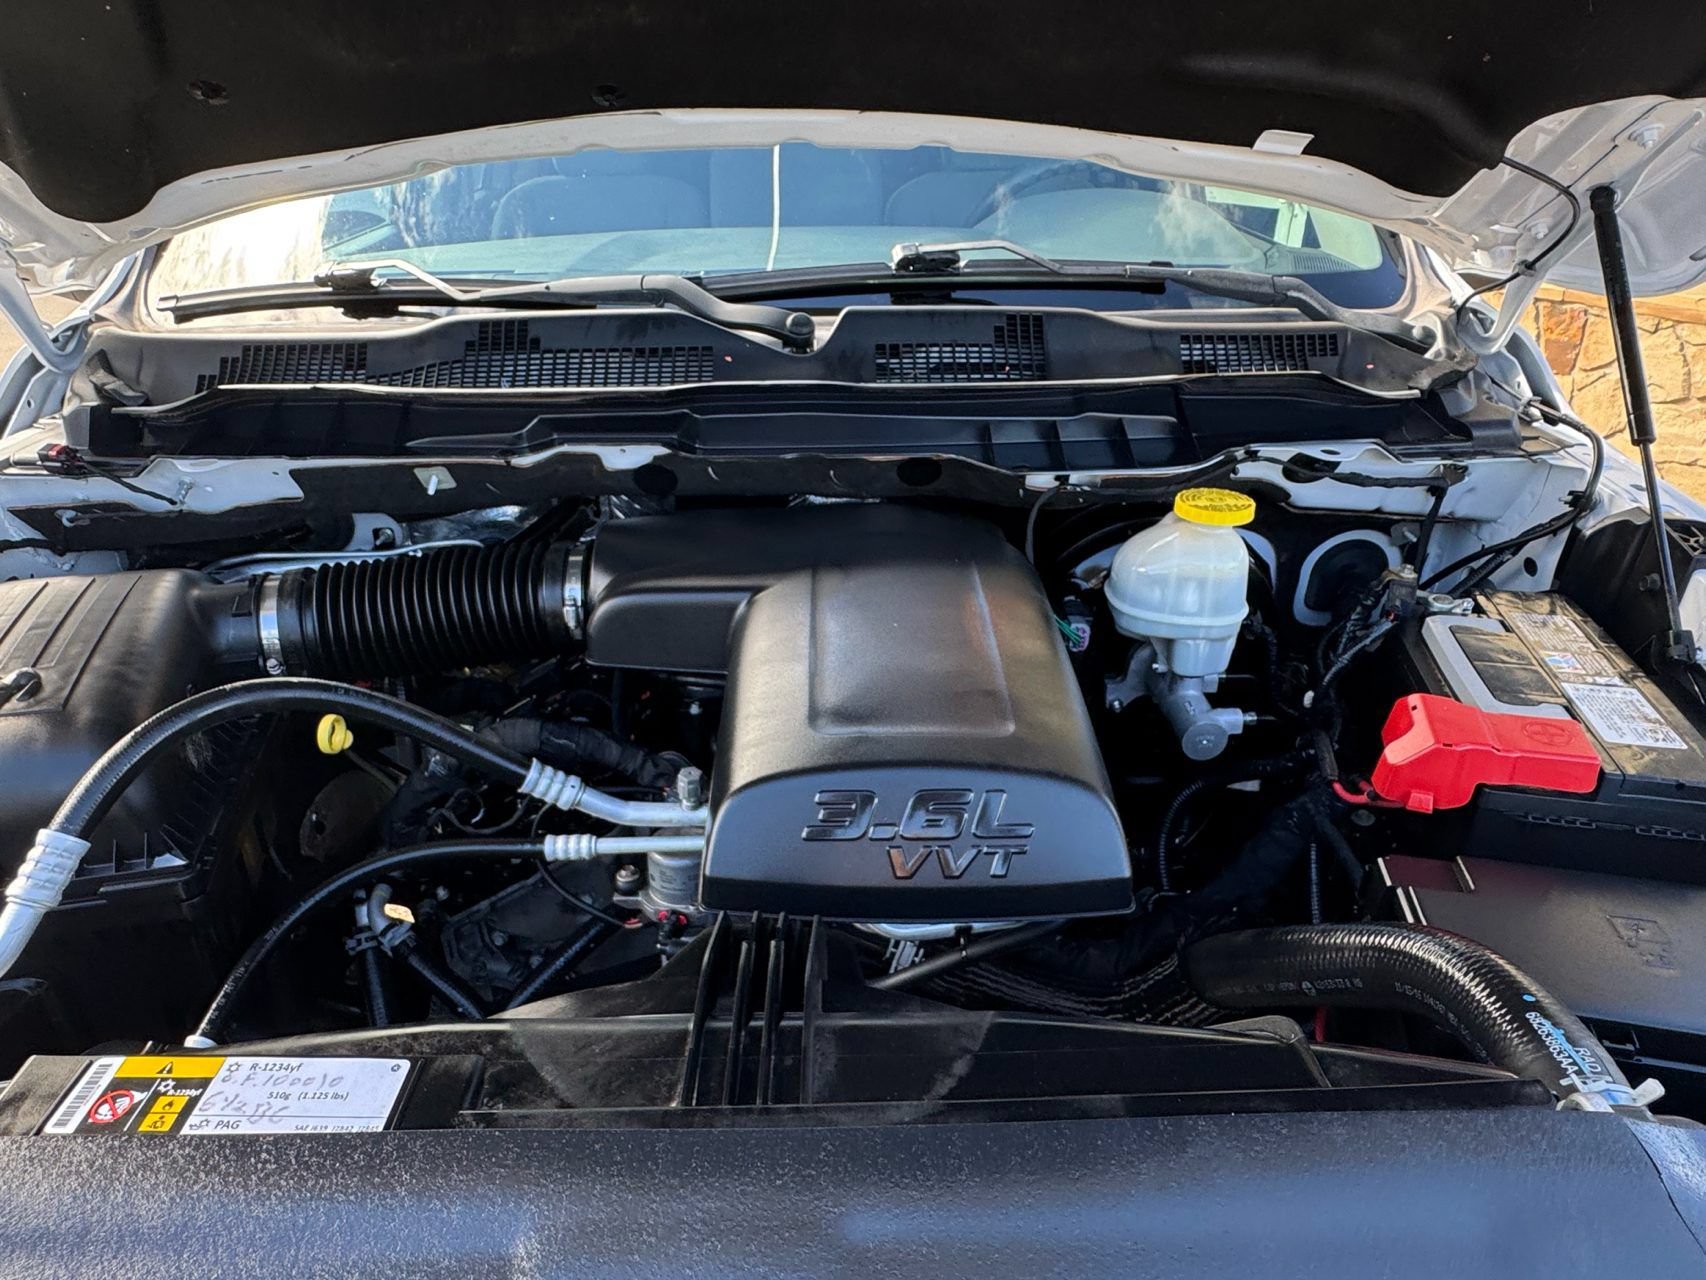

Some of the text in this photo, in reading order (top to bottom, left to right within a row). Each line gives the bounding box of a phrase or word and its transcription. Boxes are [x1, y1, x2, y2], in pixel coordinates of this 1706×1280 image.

[801, 788, 1036, 841] 3.6L
[886, 845, 1031, 879] VVT
[249, 1062, 304, 1074] R-1234yf
[1574, 1047, 1601, 1072] RAD
[266, 1091, 350, 1101] 510g (1.125 lbs)
[214, 1119, 242, 1130] PAG
